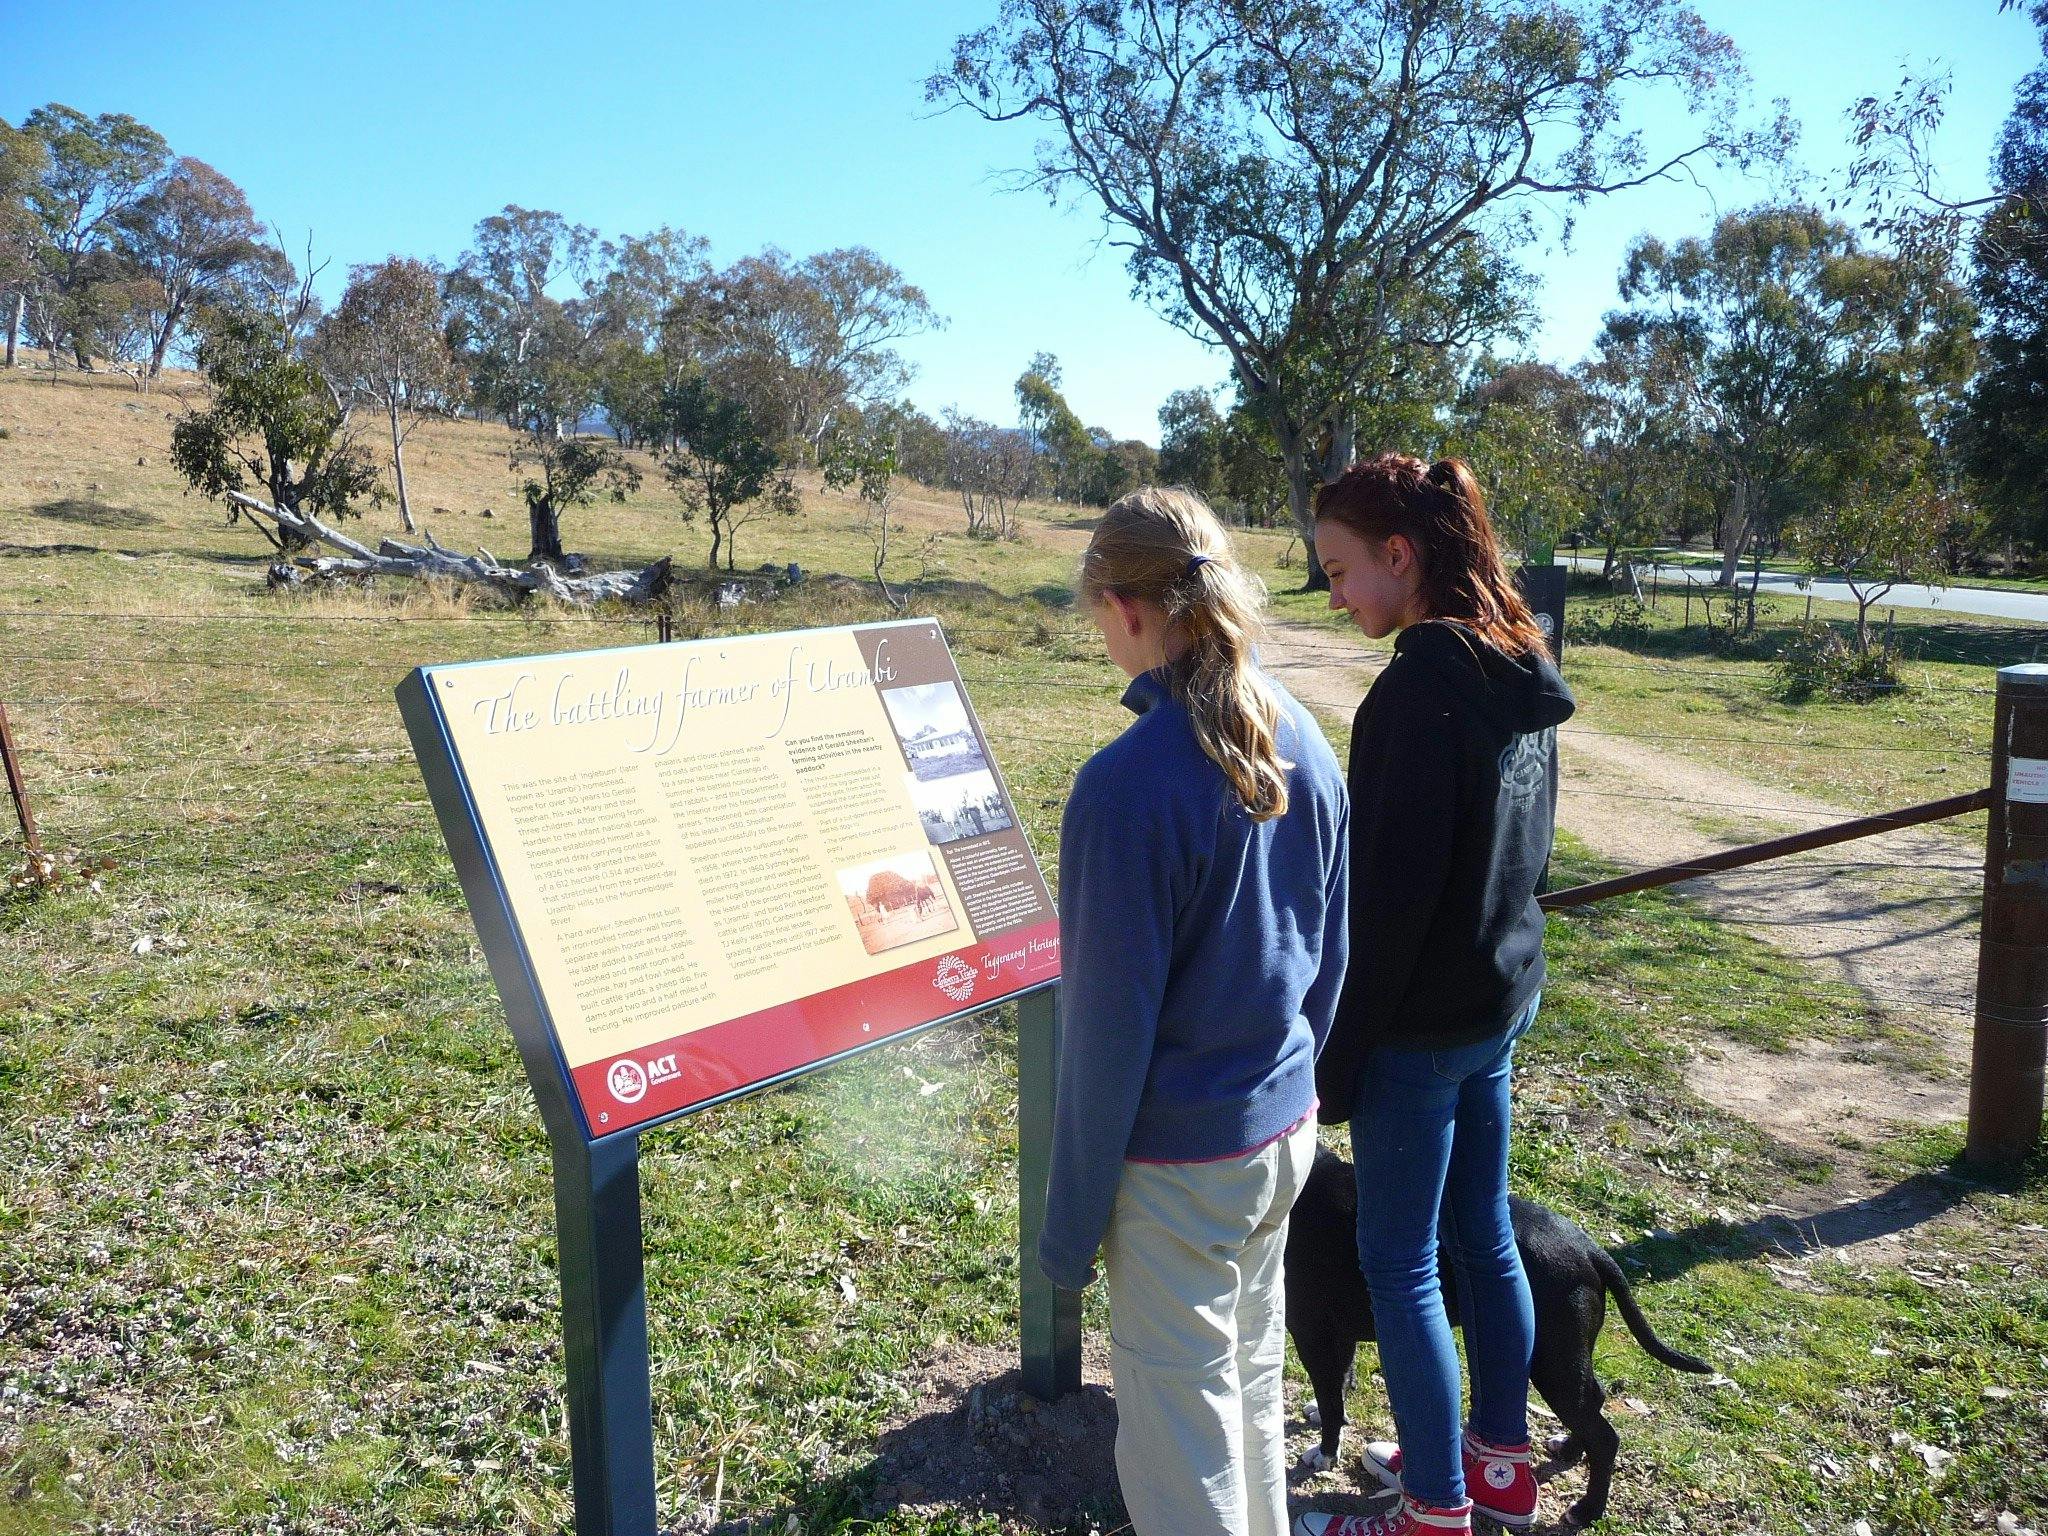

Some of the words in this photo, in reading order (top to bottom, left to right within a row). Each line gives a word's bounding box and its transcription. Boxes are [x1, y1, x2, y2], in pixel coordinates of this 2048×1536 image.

[474, 675, 538, 735] The
[551, 667, 663, 753] battling
[655, 656, 760, 755] farmer
[765, 646, 803, 739] of
[806, 639, 898, 694] Urambi
[789, 748, 817, 756] evidence
[824, 741, 846, 750] Gerald
[810, 735, 824, 743] find
[835, 730, 866, 739] remaining
[792, 756, 817, 765] farming
[817, 752, 845, 761] activities
[862, 745, 883, 753] nearby
[796, 763, 826, 776] paddock?
[502, 783, 520, 791] This
[553, 775, 568, 783] site
[510, 805, 534, 814] home
[580, 794, 601, 804] years
[611, 786, 636, 797] Gerald
[565, 807, 583, 816] wife
[582, 805, 603, 813] Mary
[619, 798, 636, 806] their
[518, 828, 540, 836] three
[575, 817, 597, 826] After
[597, 812, 627, 822] moving
[522, 837, 553, 847] Harden
[577, 826, 601, 837] infant
[602, 820, 632, 832] national
[526, 847, 561, 858] Sheehan
[562, 837, 607, 851] established
[606, 831, 635, 843] himself
[592, 856, 623, 871] granted
[637, 852, 657, 860] lease
[542, 894, 560, 904] that
[560, 885, 599, 900] stretched
[599, 883, 618, 892] from
[633, 870, 678, 886] present-day
[563, 928, 584, 940] hard
[613, 915, 648, 928] Sheehan
[647, 910, 663, 920] first
[663, 906, 681, 916] built
[571, 933, 617, 950] iron-roofed
[617, 923, 660, 939] timber-wall
[1028, 937, 1060, 960] Heritage
[645, 970, 662, 981] fowl
[580, 999, 600, 1011] built
[600, 994, 624, 1006] cattle
[655, 980, 679, 991] sheep
[693, 972, 708, 980] five
[584, 1012, 607, 1023] dams
[663, 990, 679, 1000] half
[679, 986, 699, 996] miles
[634, 1004, 671, 1021] improved
[672, 998, 700, 1012] pasture
[701, 991, 717, 1002] with
[647, 1054, 678, 1079] ACT
[650, 1071, 682, 1086] Government
